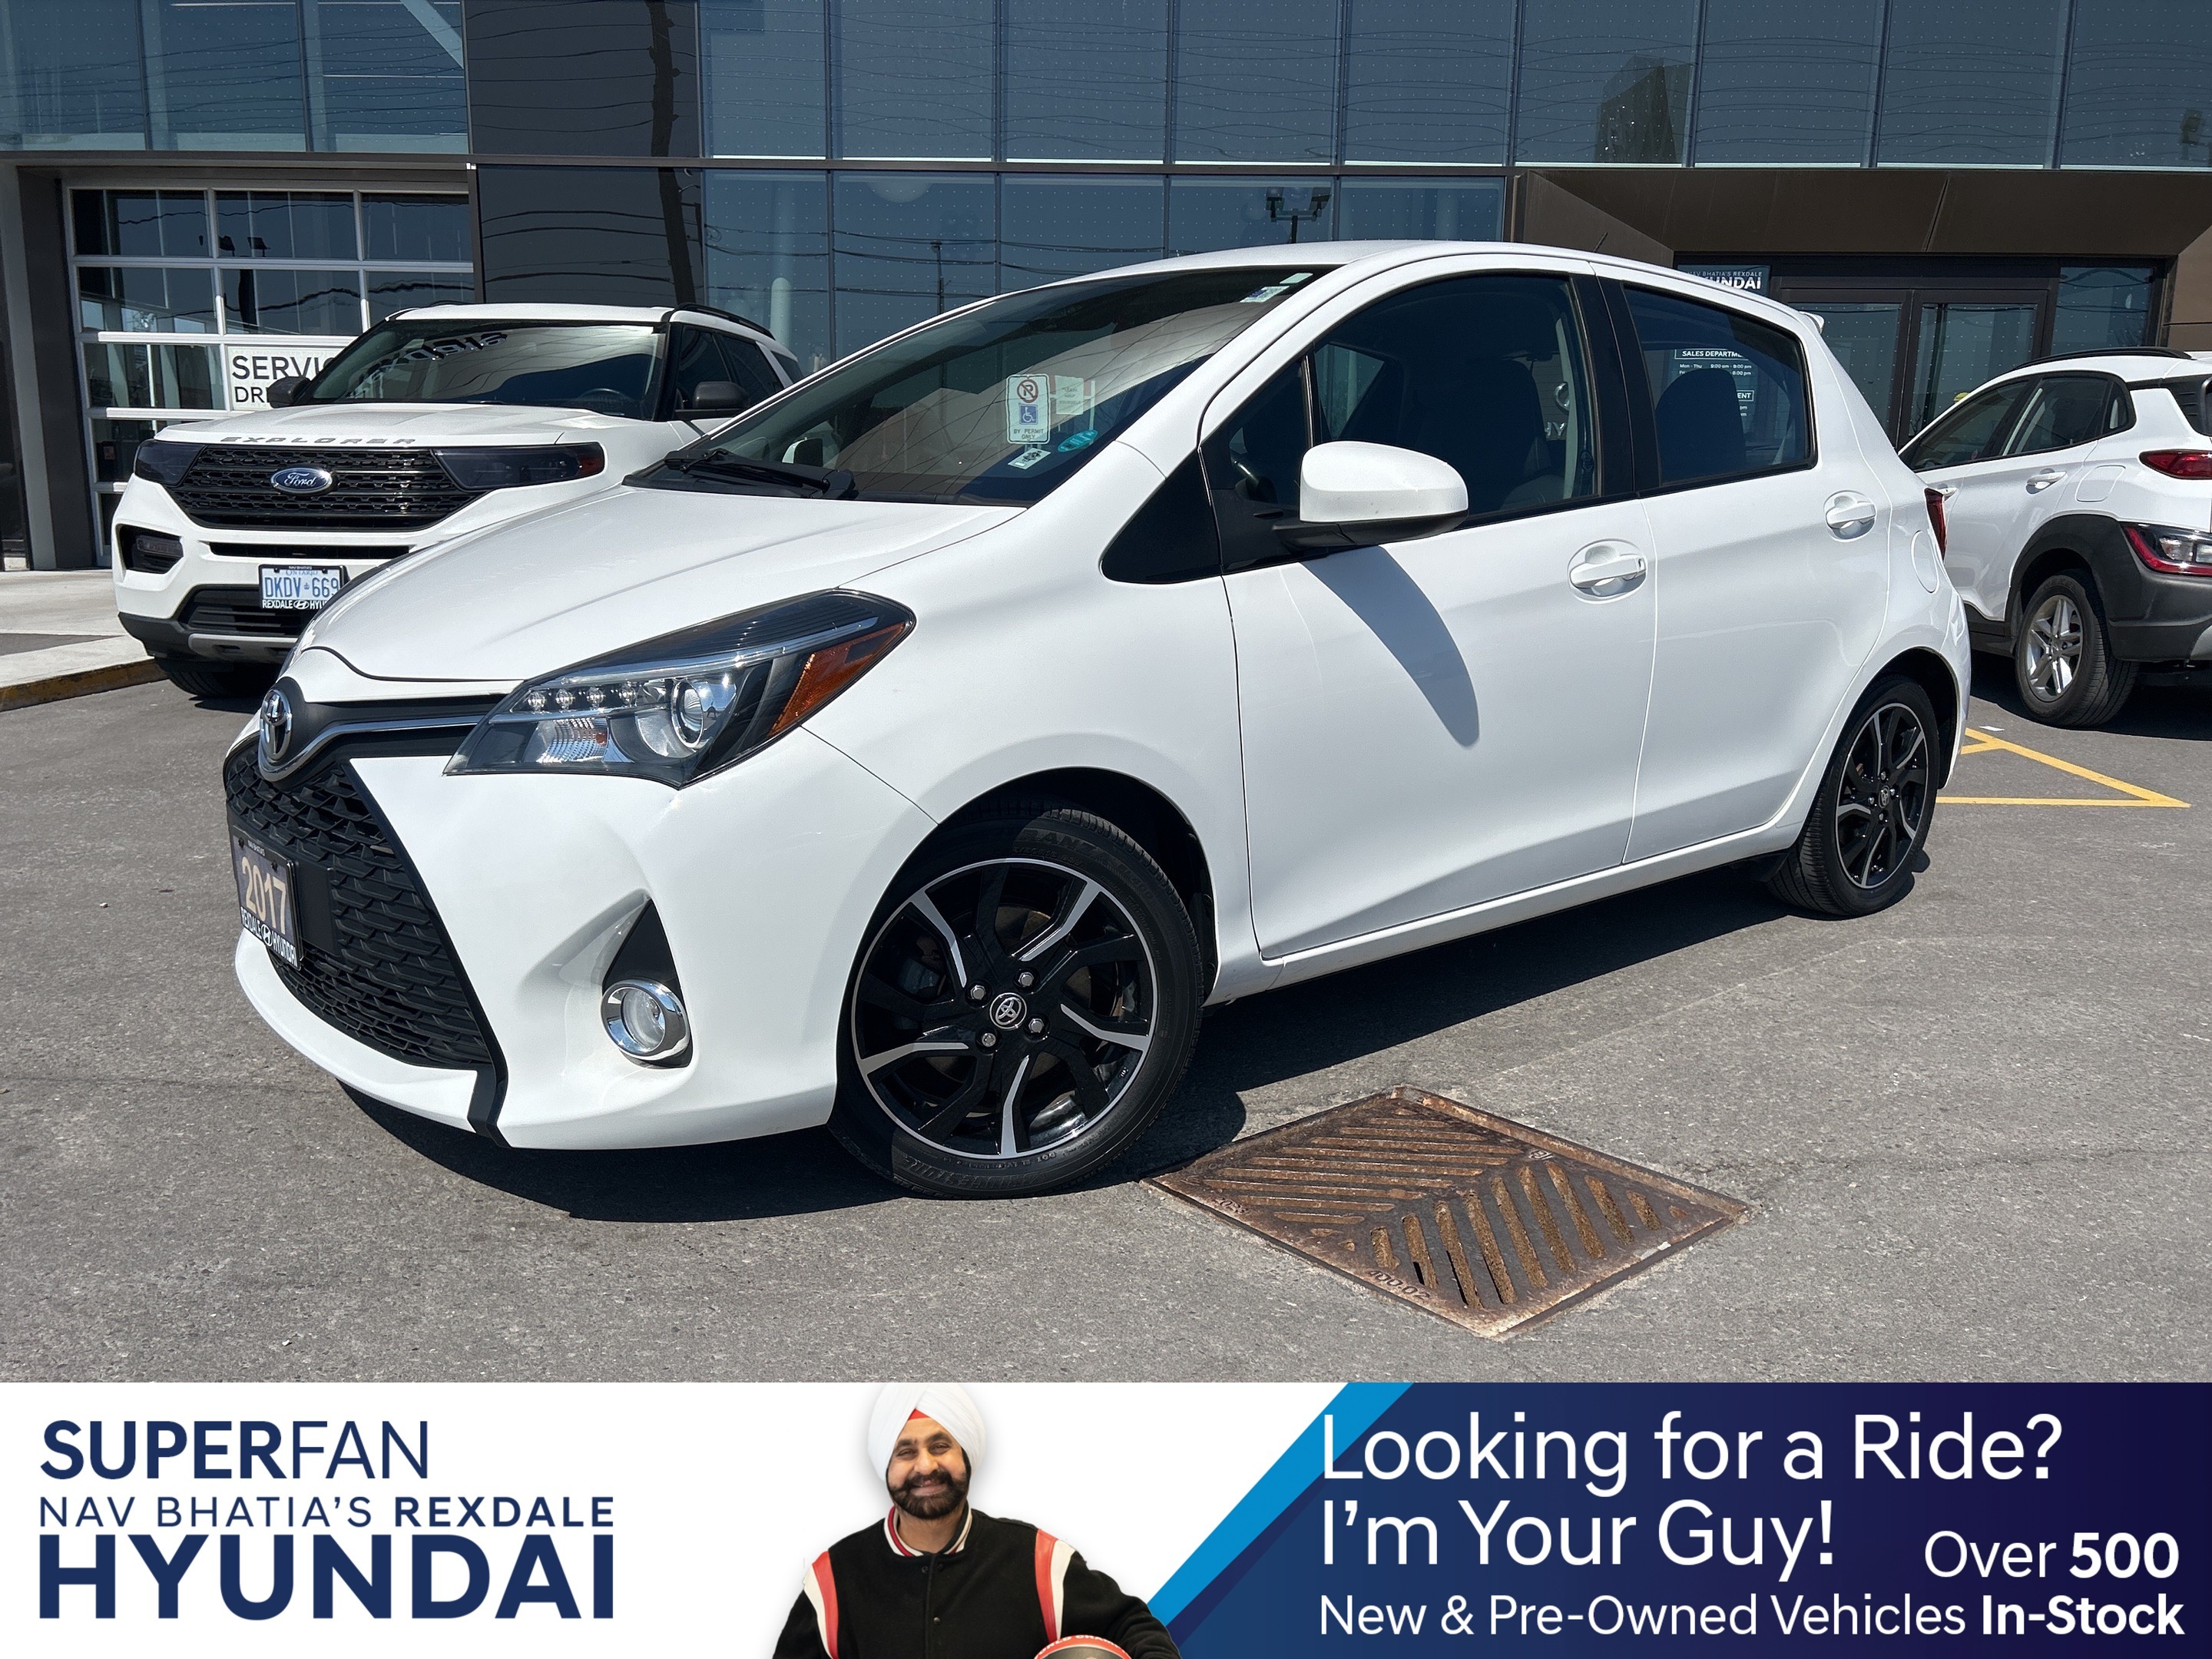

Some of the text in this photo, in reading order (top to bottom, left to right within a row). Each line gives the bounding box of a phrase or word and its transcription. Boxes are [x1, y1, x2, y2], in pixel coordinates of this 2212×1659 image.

[220, 436, 416, 445] EXPLORER
[283, 472, 317, 487] Ford
[264, 577, 339, 598] DKDV 669
[263, 600, 293, 608] REXDALE
[242, 856, 286, 935] 2017
